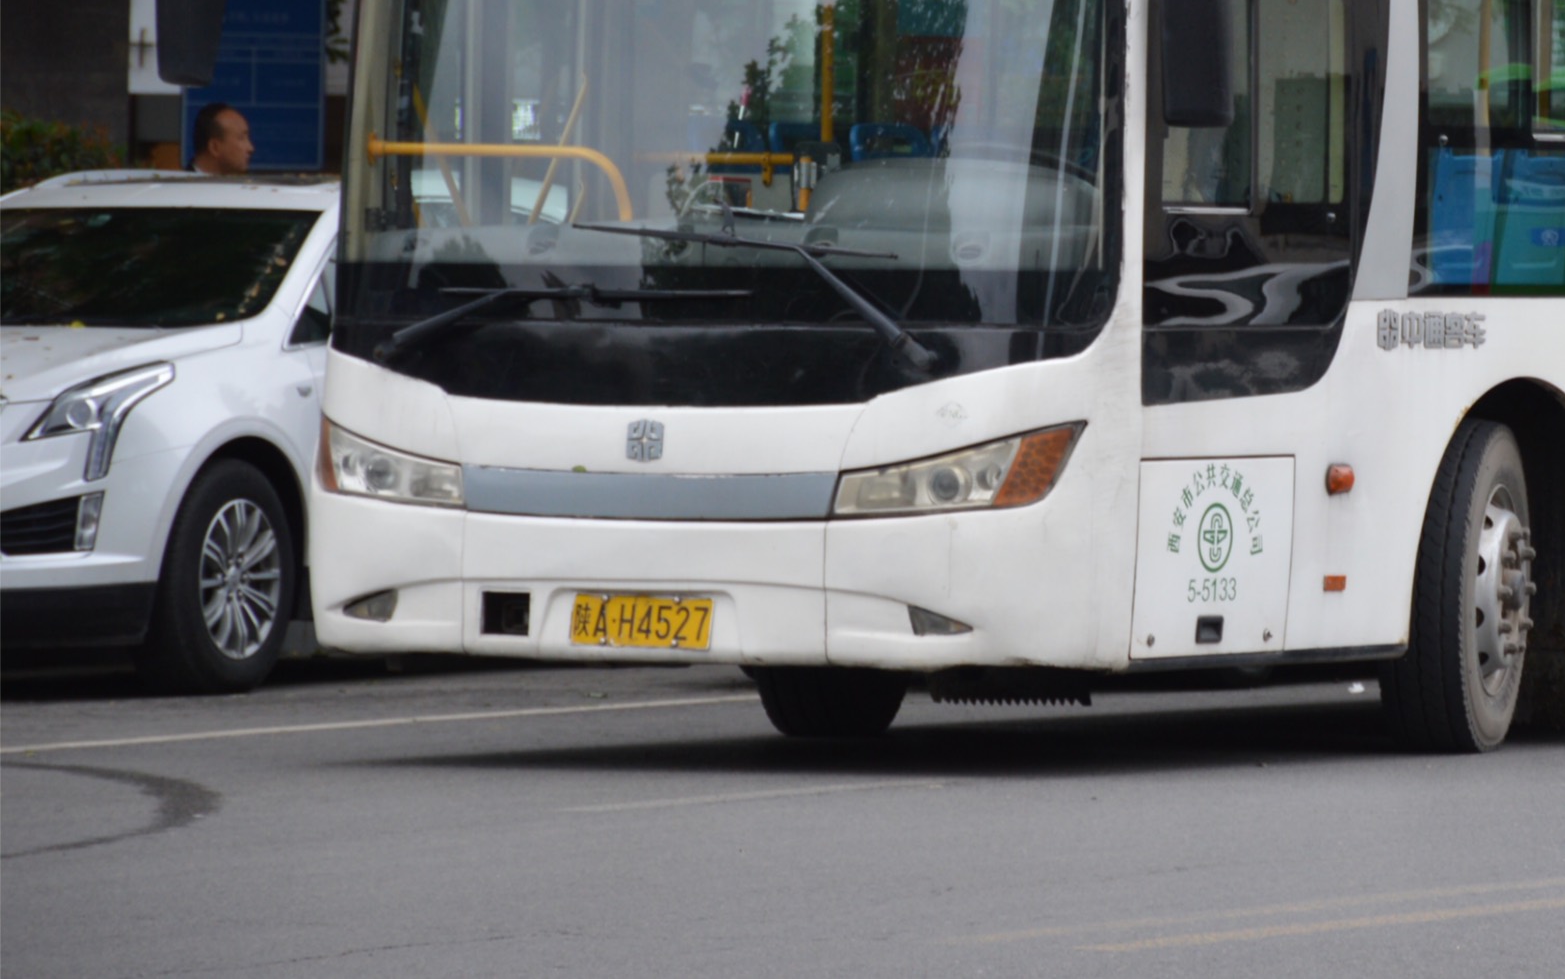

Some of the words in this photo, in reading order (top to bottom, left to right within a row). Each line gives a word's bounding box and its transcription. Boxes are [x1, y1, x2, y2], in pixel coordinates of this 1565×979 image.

[1400, 310, 1487, 350] 中通客车
[1166, 462, 1264, 556] 西安市公共交通总公司
[1187, 577, 1237, 603] 5-5133
